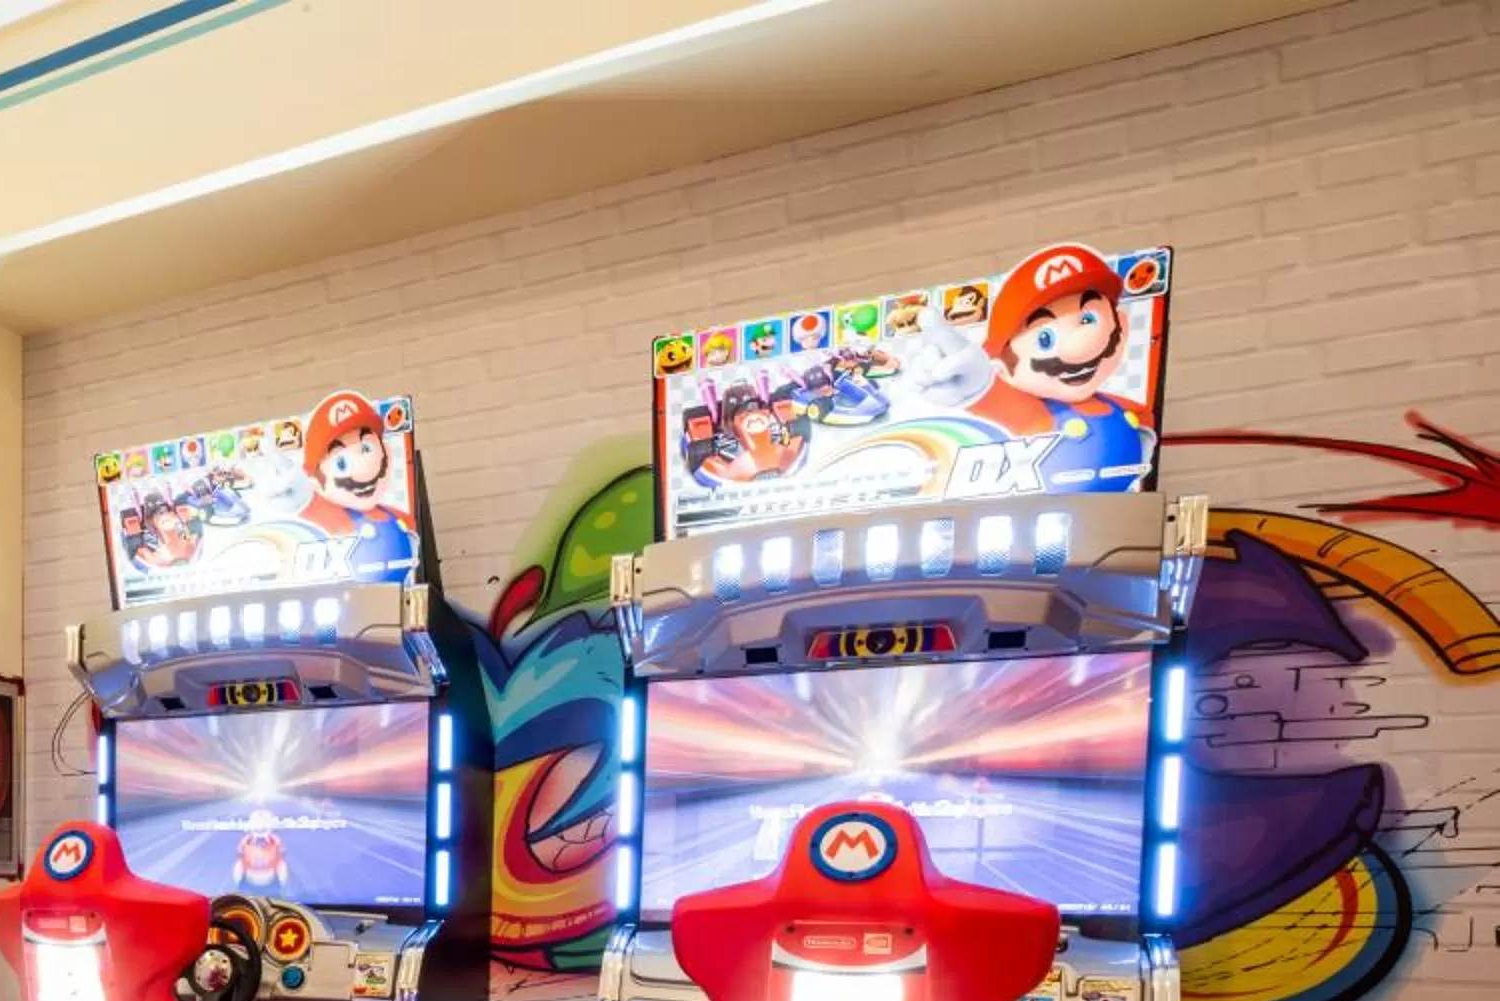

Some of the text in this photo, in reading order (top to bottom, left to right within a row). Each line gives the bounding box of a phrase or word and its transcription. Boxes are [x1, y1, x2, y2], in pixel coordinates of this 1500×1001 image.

[945, 433, 1062, 497] DX
[52, 844, 82, 863] M
[825, 829, 879, 859] M
